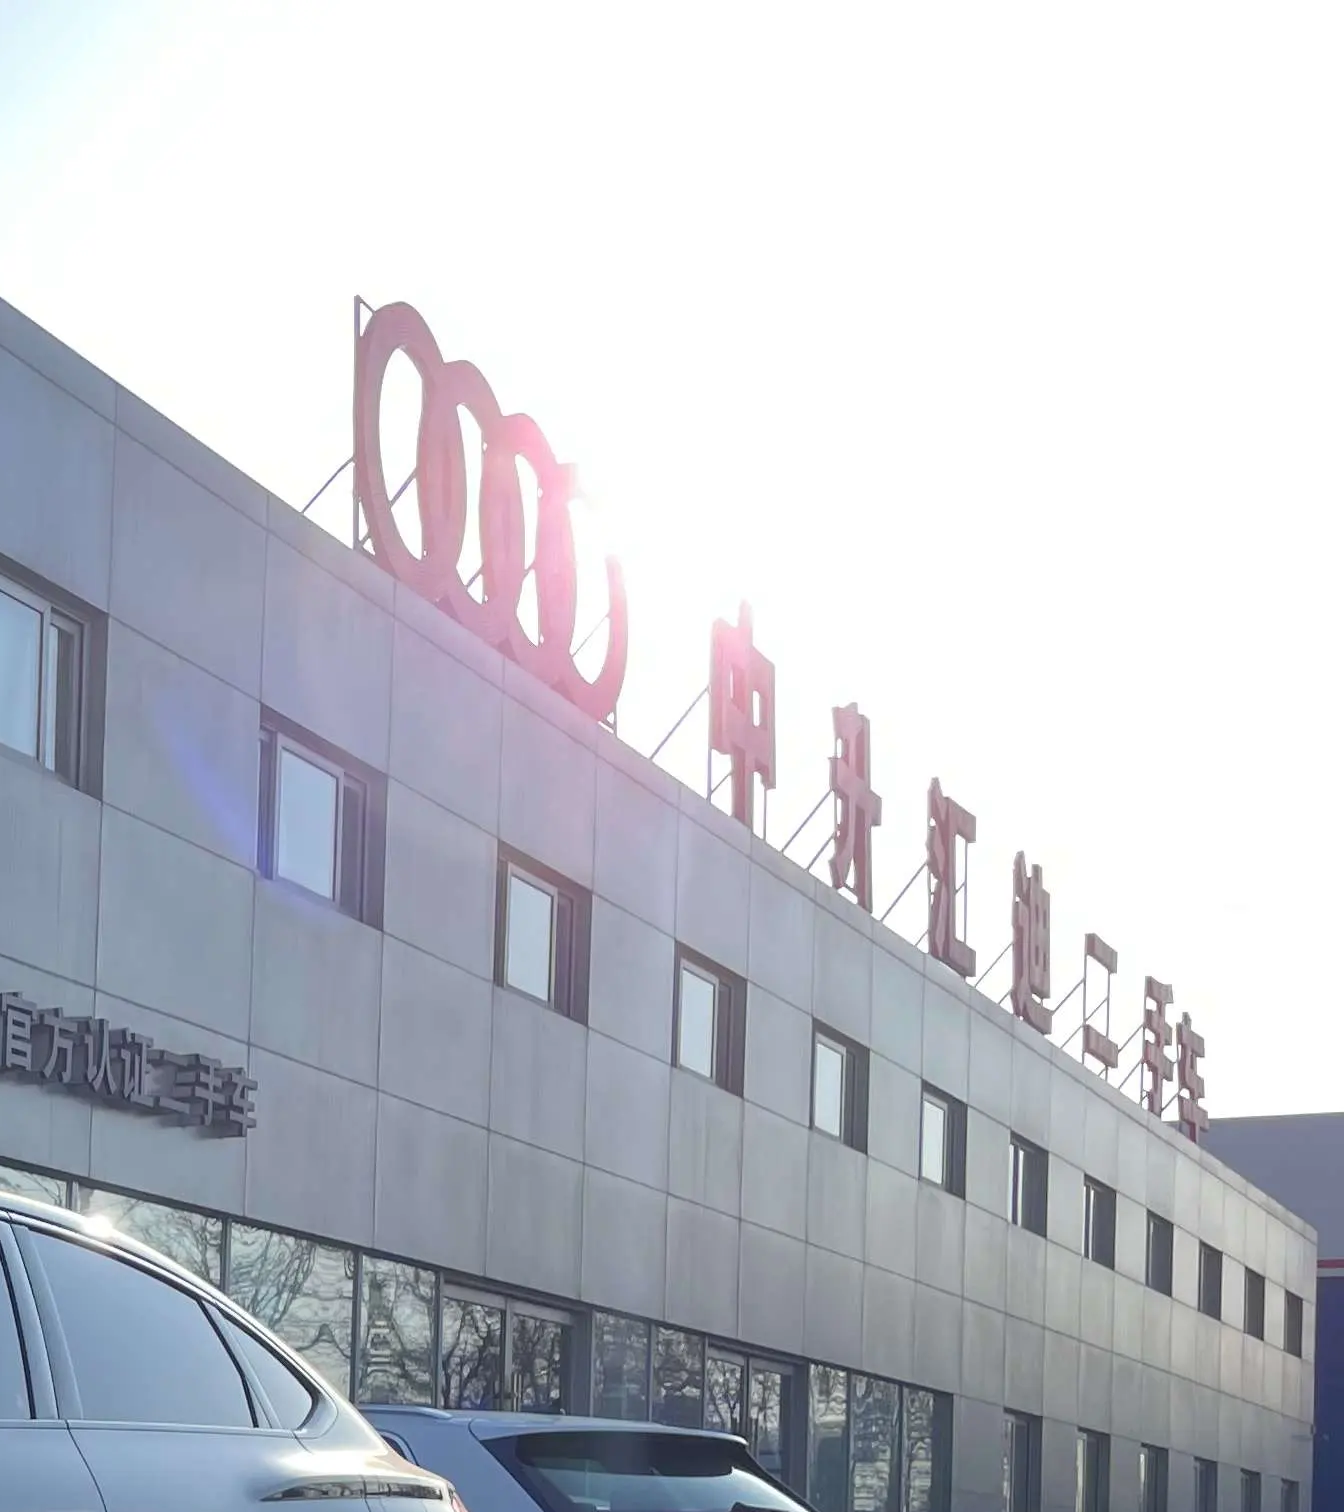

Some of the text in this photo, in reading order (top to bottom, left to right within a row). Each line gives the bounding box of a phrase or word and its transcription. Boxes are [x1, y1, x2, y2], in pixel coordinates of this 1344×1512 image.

[2, 992, 258, 1138] 官方认证二手车
